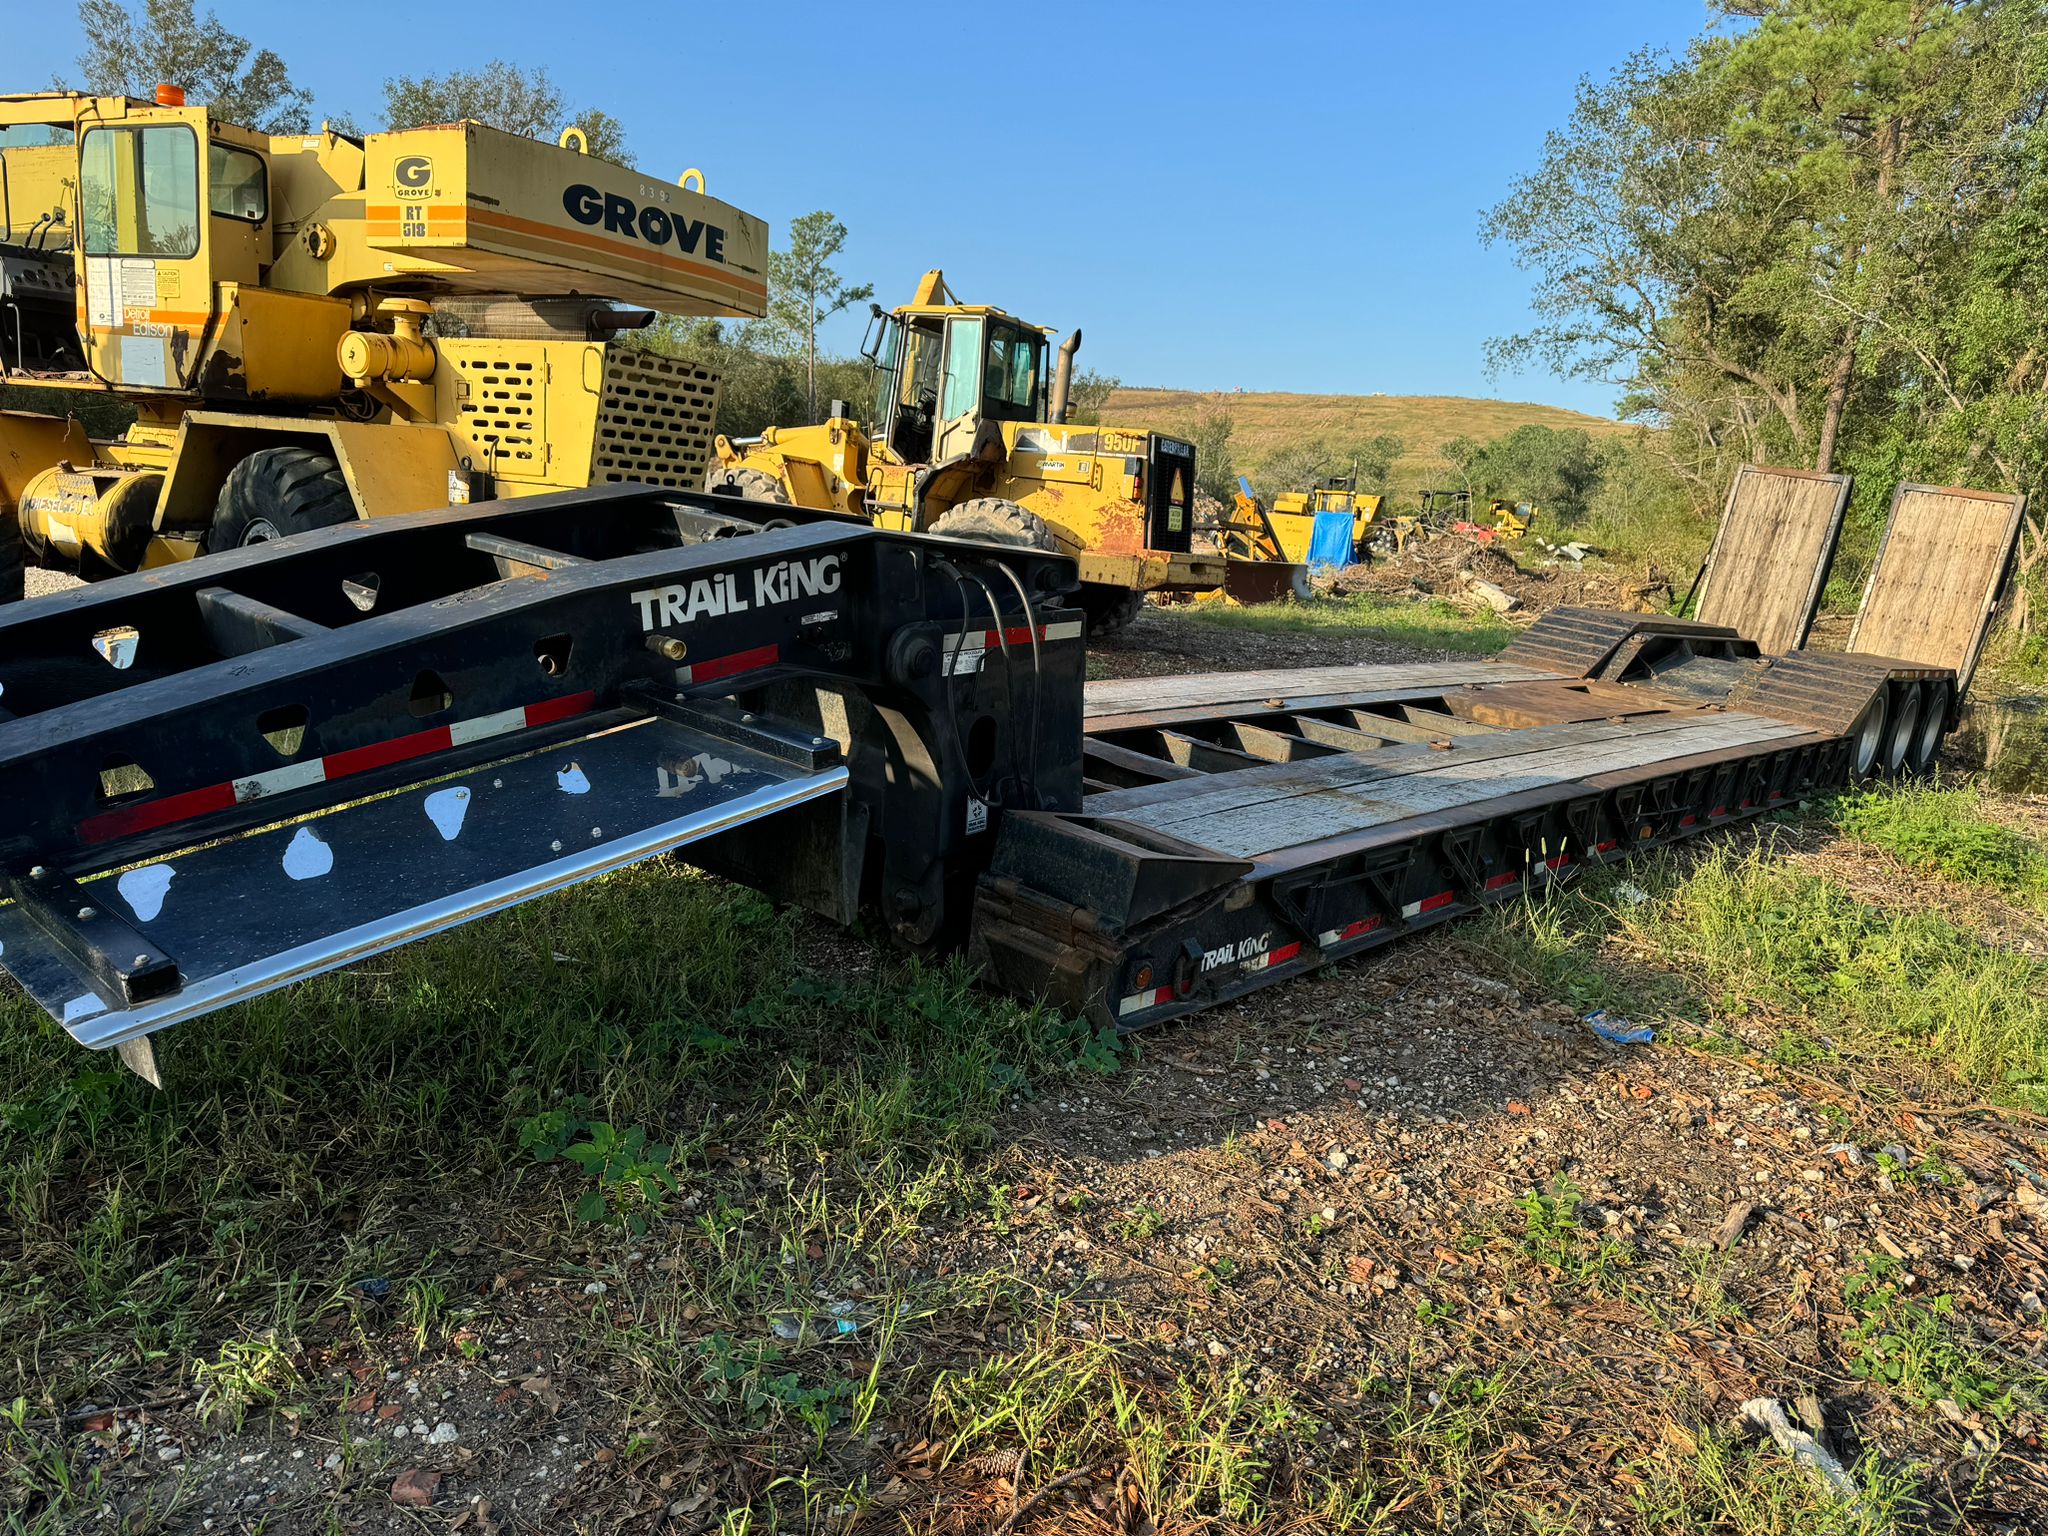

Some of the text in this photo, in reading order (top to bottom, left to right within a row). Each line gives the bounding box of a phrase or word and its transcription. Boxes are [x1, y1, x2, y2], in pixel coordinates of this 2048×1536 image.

[396, 157, 431, 187] G
[406, 206, 422, 220] RT
[403, 222, 426, 237] 518
[563, 184, 725, 264] GROVE
[124, 308, 151, 320] Detroit
[133, 321, 173, 337] Edison
[1104, 433, 1140, 453] 950F
[31, 497, 64, 513] DIESEL
